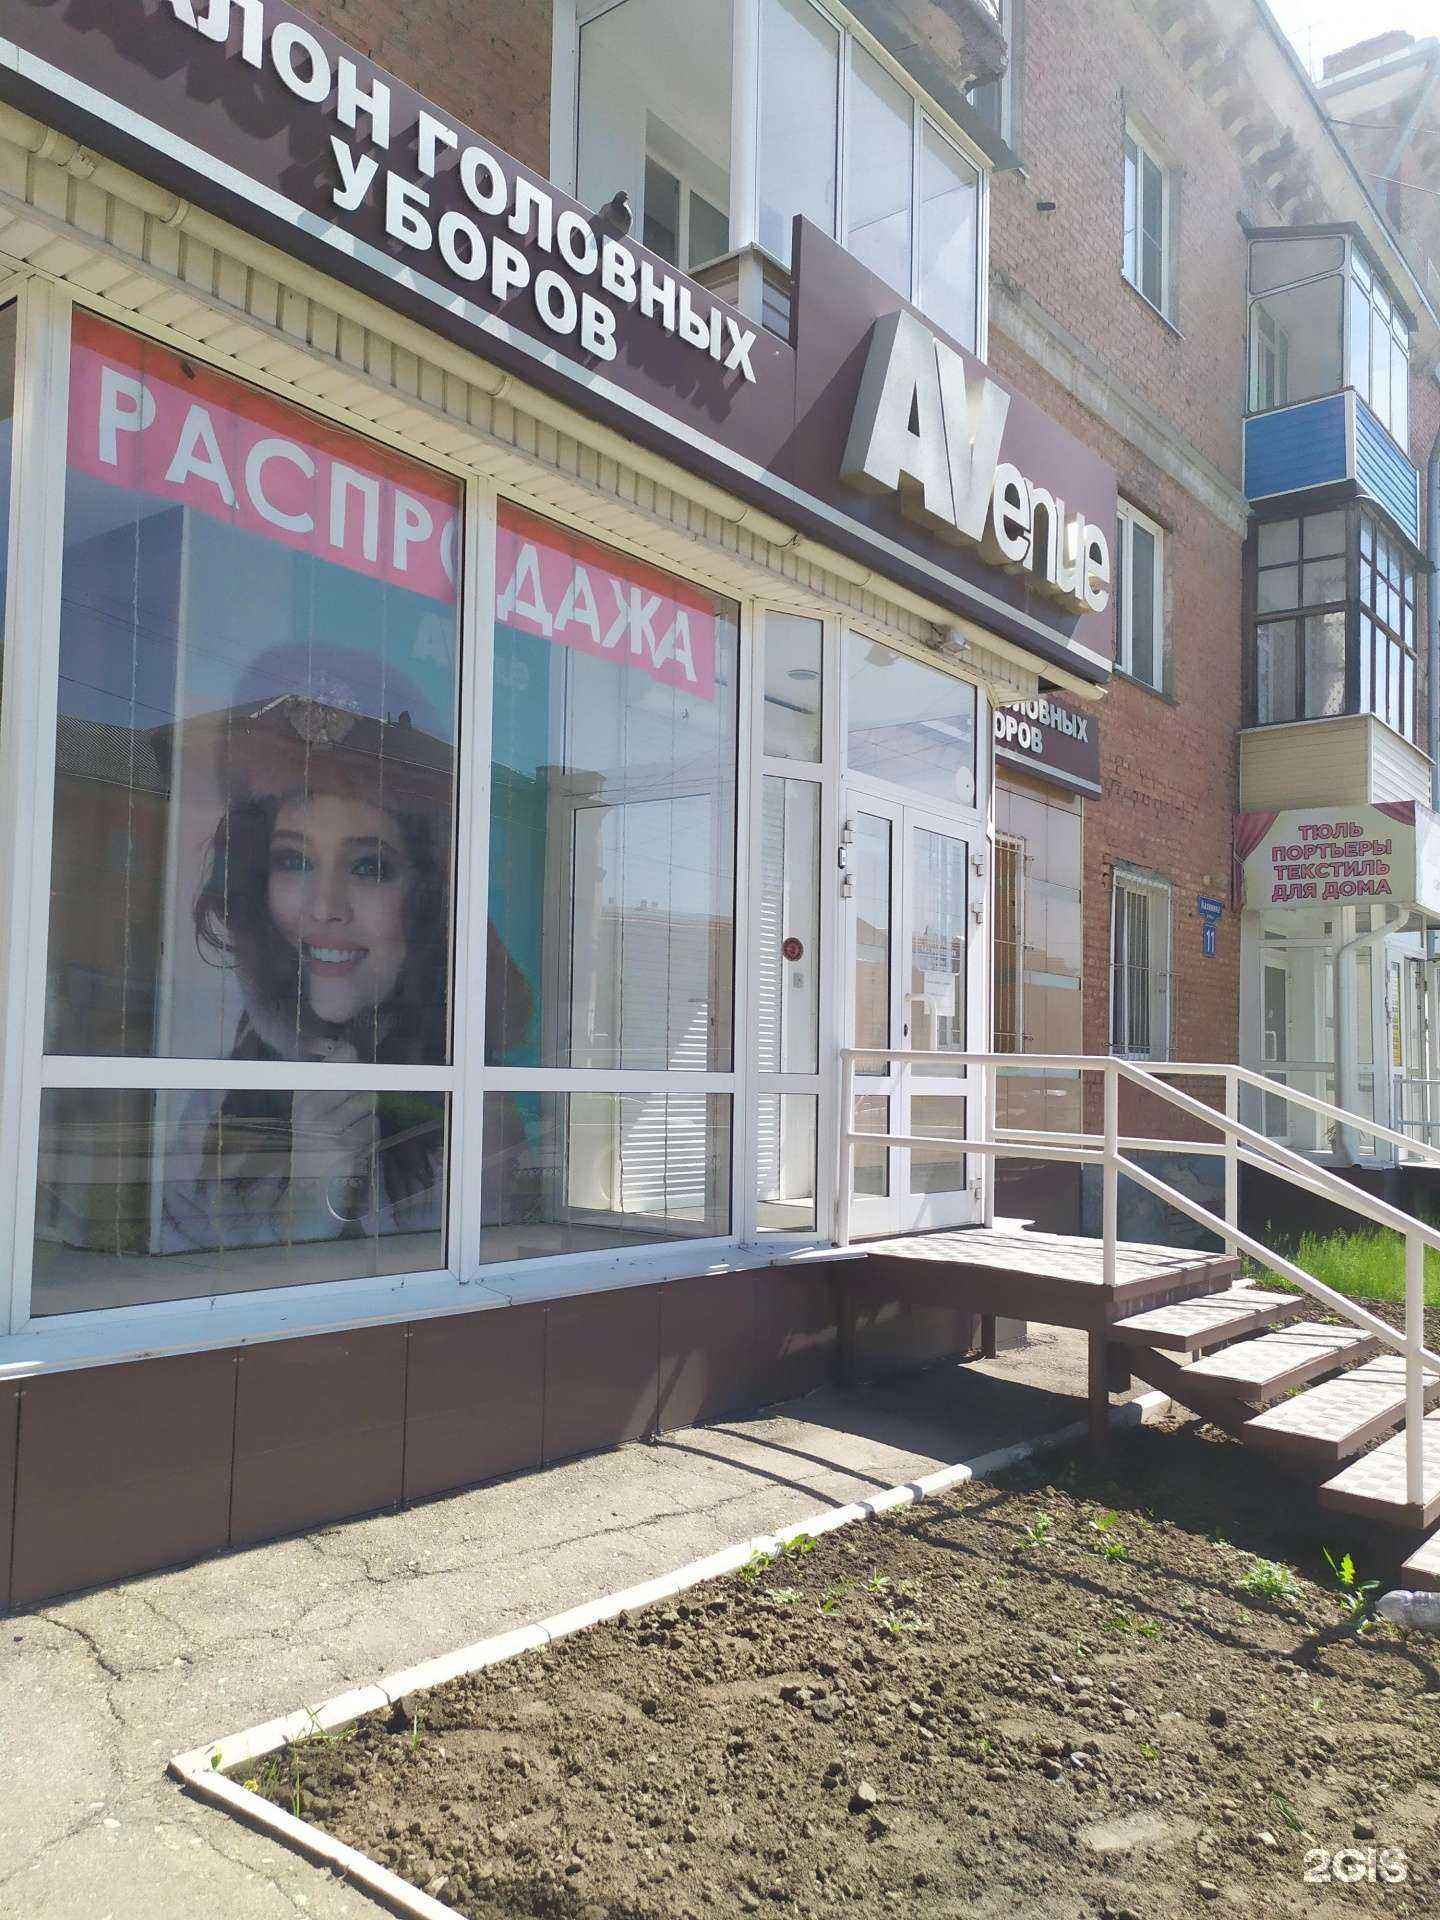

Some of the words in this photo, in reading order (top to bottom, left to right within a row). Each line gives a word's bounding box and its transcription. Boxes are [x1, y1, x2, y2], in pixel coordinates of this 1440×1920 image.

[329, 134, 618, 363] УБОРОВ
[417, 110, 758, 385] ГОЛОВНЫХ
[1298, 822, 1364, 841] ТЮЛЬ
[1271, 839, 1393, 862] ПОРТЬЕРЫ
[1273, 859, 1391, 881] ТЕКСТИЛЬ
[1271, 882, 1318, 903] ДЛЯ
[1322, 879, 1393, 901] ДОМА
